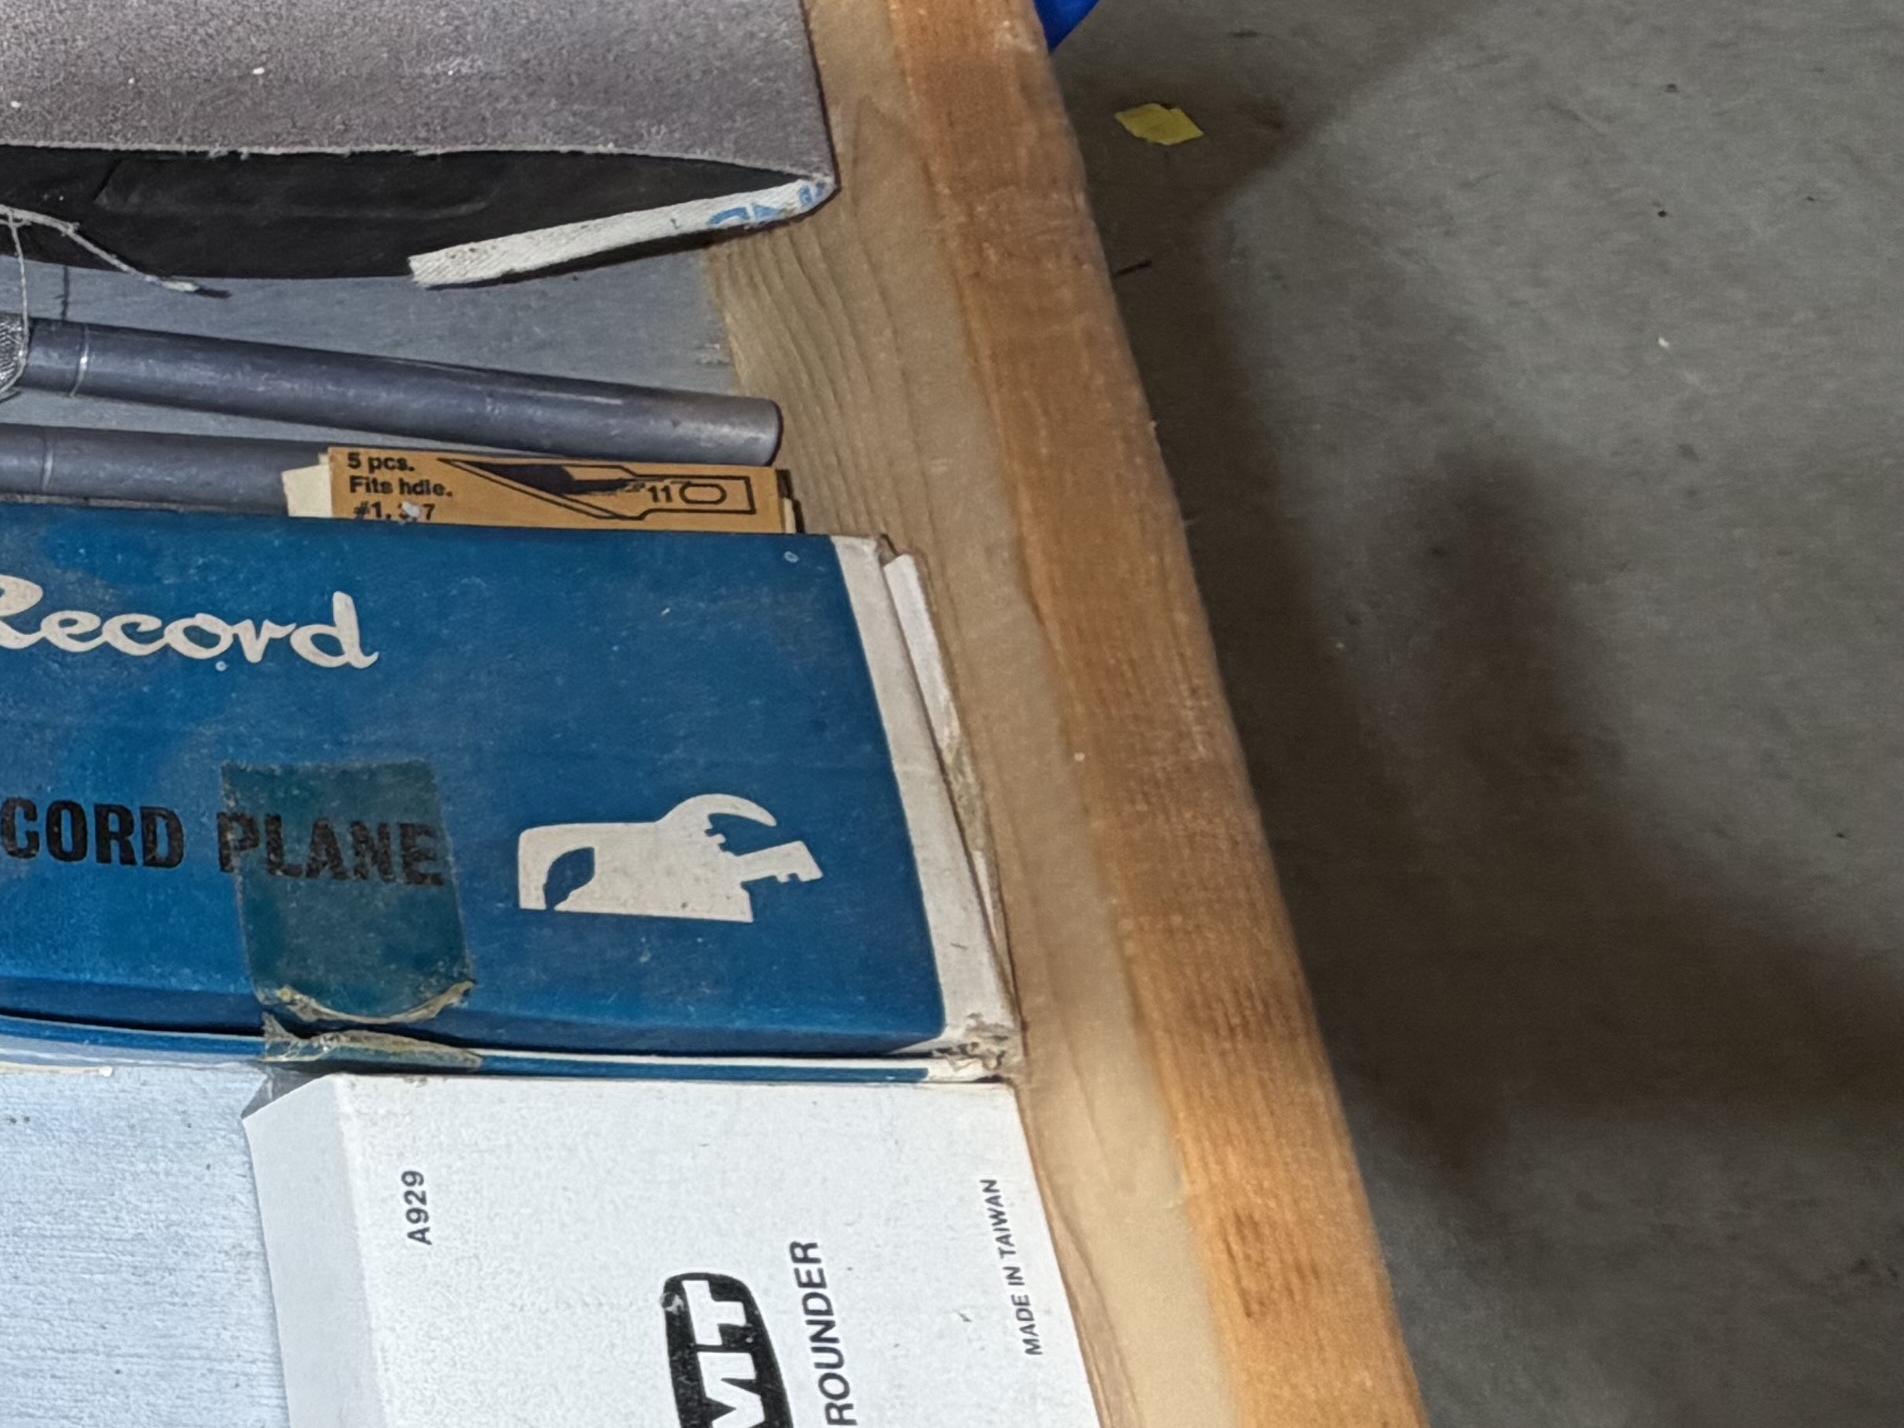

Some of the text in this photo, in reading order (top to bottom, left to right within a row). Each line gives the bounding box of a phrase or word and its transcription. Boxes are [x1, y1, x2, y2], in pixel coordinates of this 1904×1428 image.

[347, 452, 415, 474] 5 pcs.
[349, 475, 393, 494] Fits
[646, 485, 673, 503] 11
[216, 811, 445, 887] PLANE
[401, 1170, 432, 1246] A929
[980, 1179, 1044, 1356] MADE IN TAIWAN
[789, 1240, 857, 1427] ROUNDER
